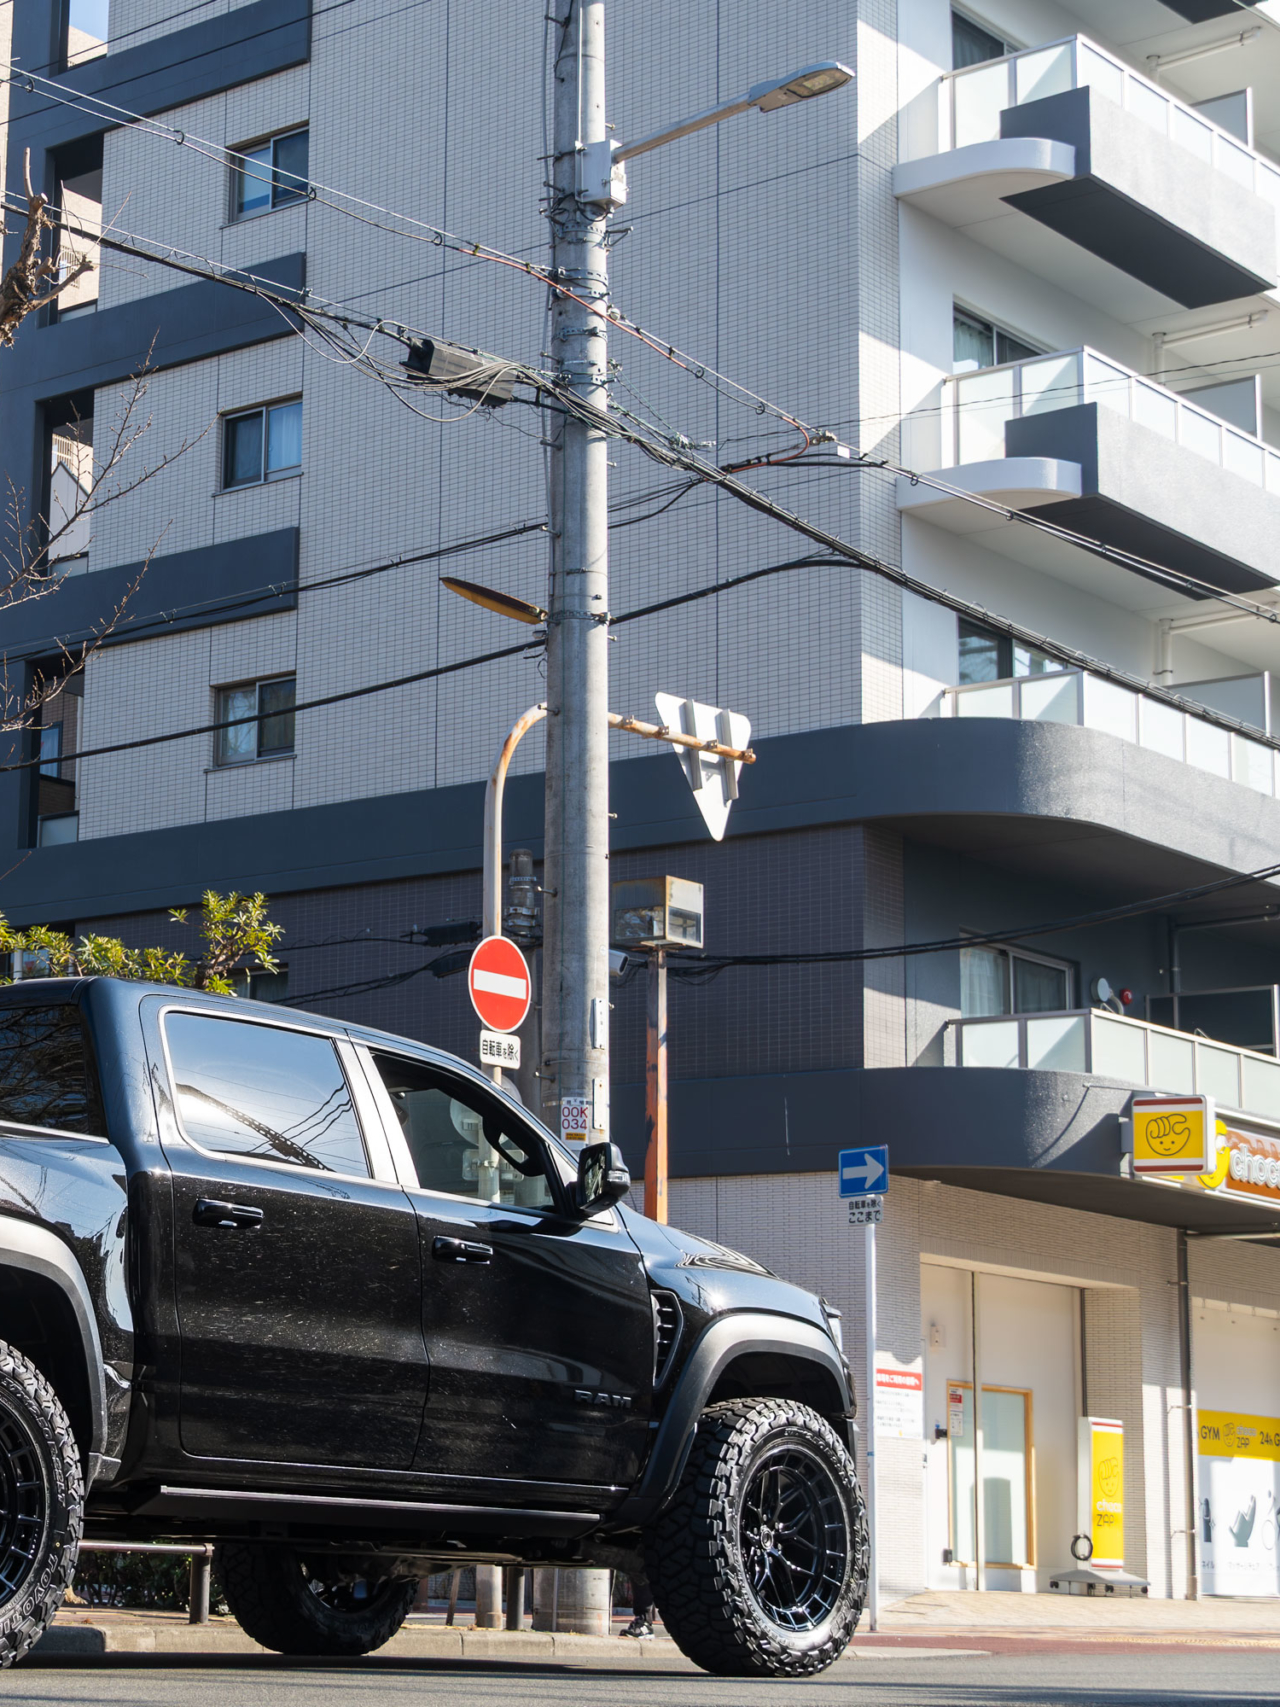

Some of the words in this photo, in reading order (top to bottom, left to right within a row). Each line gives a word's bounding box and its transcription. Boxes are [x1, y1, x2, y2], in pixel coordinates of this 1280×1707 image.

[482, 1039, 518, 1061] 自転車を除く
[561, 1118, 588, 1130] 034
[1229, 1142, 1280, 1188] choc
[848, 1199, 881, 1210] 自転車を除く
[848, 1210, 881, 1224] ここまで
[575, 1389, 632, 1409] RAM
[1200, 1425, 1221, 1441] GYM
[1096, 1513, 1115, 1527] ZAP
[22, 1553, 59, 1616] TOYO
